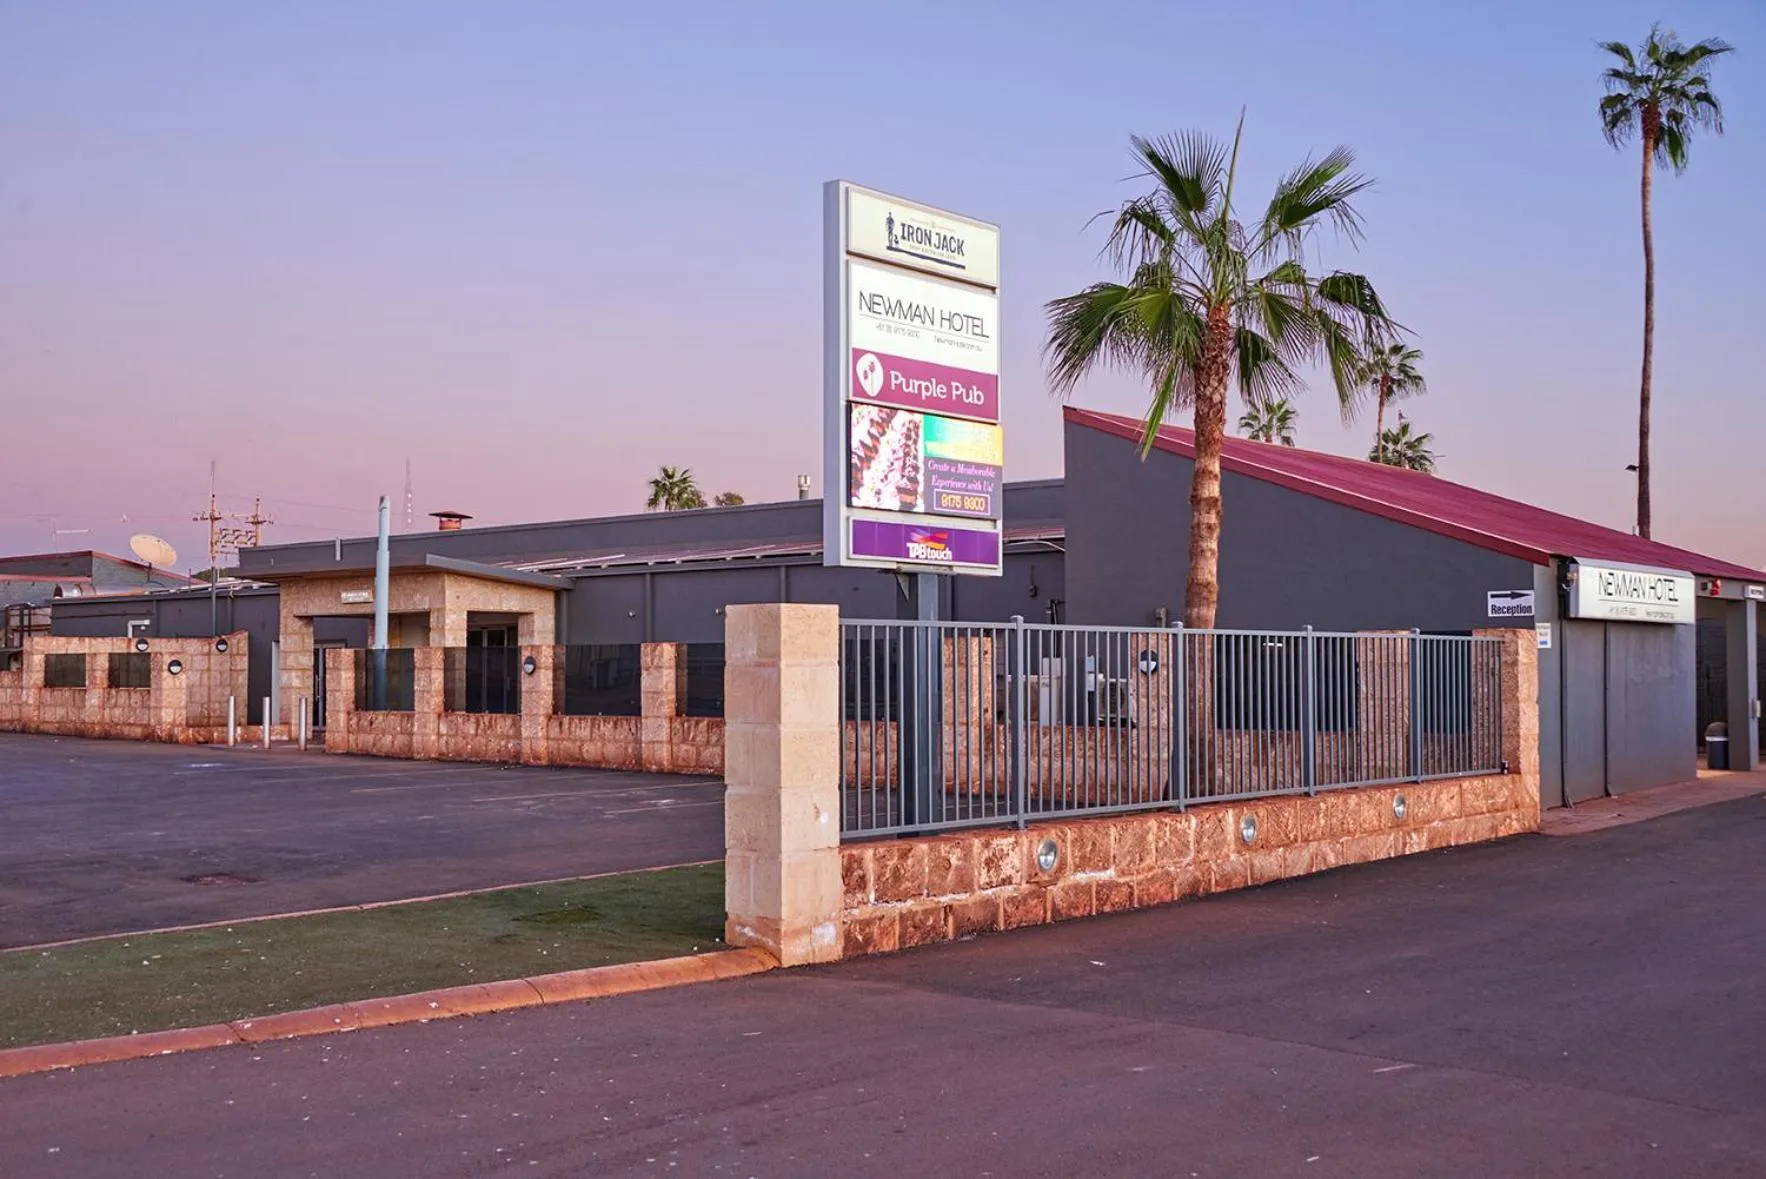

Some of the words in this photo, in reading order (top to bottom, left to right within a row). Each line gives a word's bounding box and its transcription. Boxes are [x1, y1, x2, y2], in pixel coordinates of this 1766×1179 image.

[901, 222, 933, 248] IRON
[933, 232, 965, 256] JACK
[859, 290, 935, 327] NEWMAN
[940, 309, 989, 339] HOTEL
[889, 370, 947, 400] Purple
[951, 381, 985, 405] Pub
[928, 459, 950, 471] Create
[1598, 571, 1646, 600] NEWMAN
[1649, 576, 1679, 602] HOTEL
[1490, 604, 1533, 616] Reception
